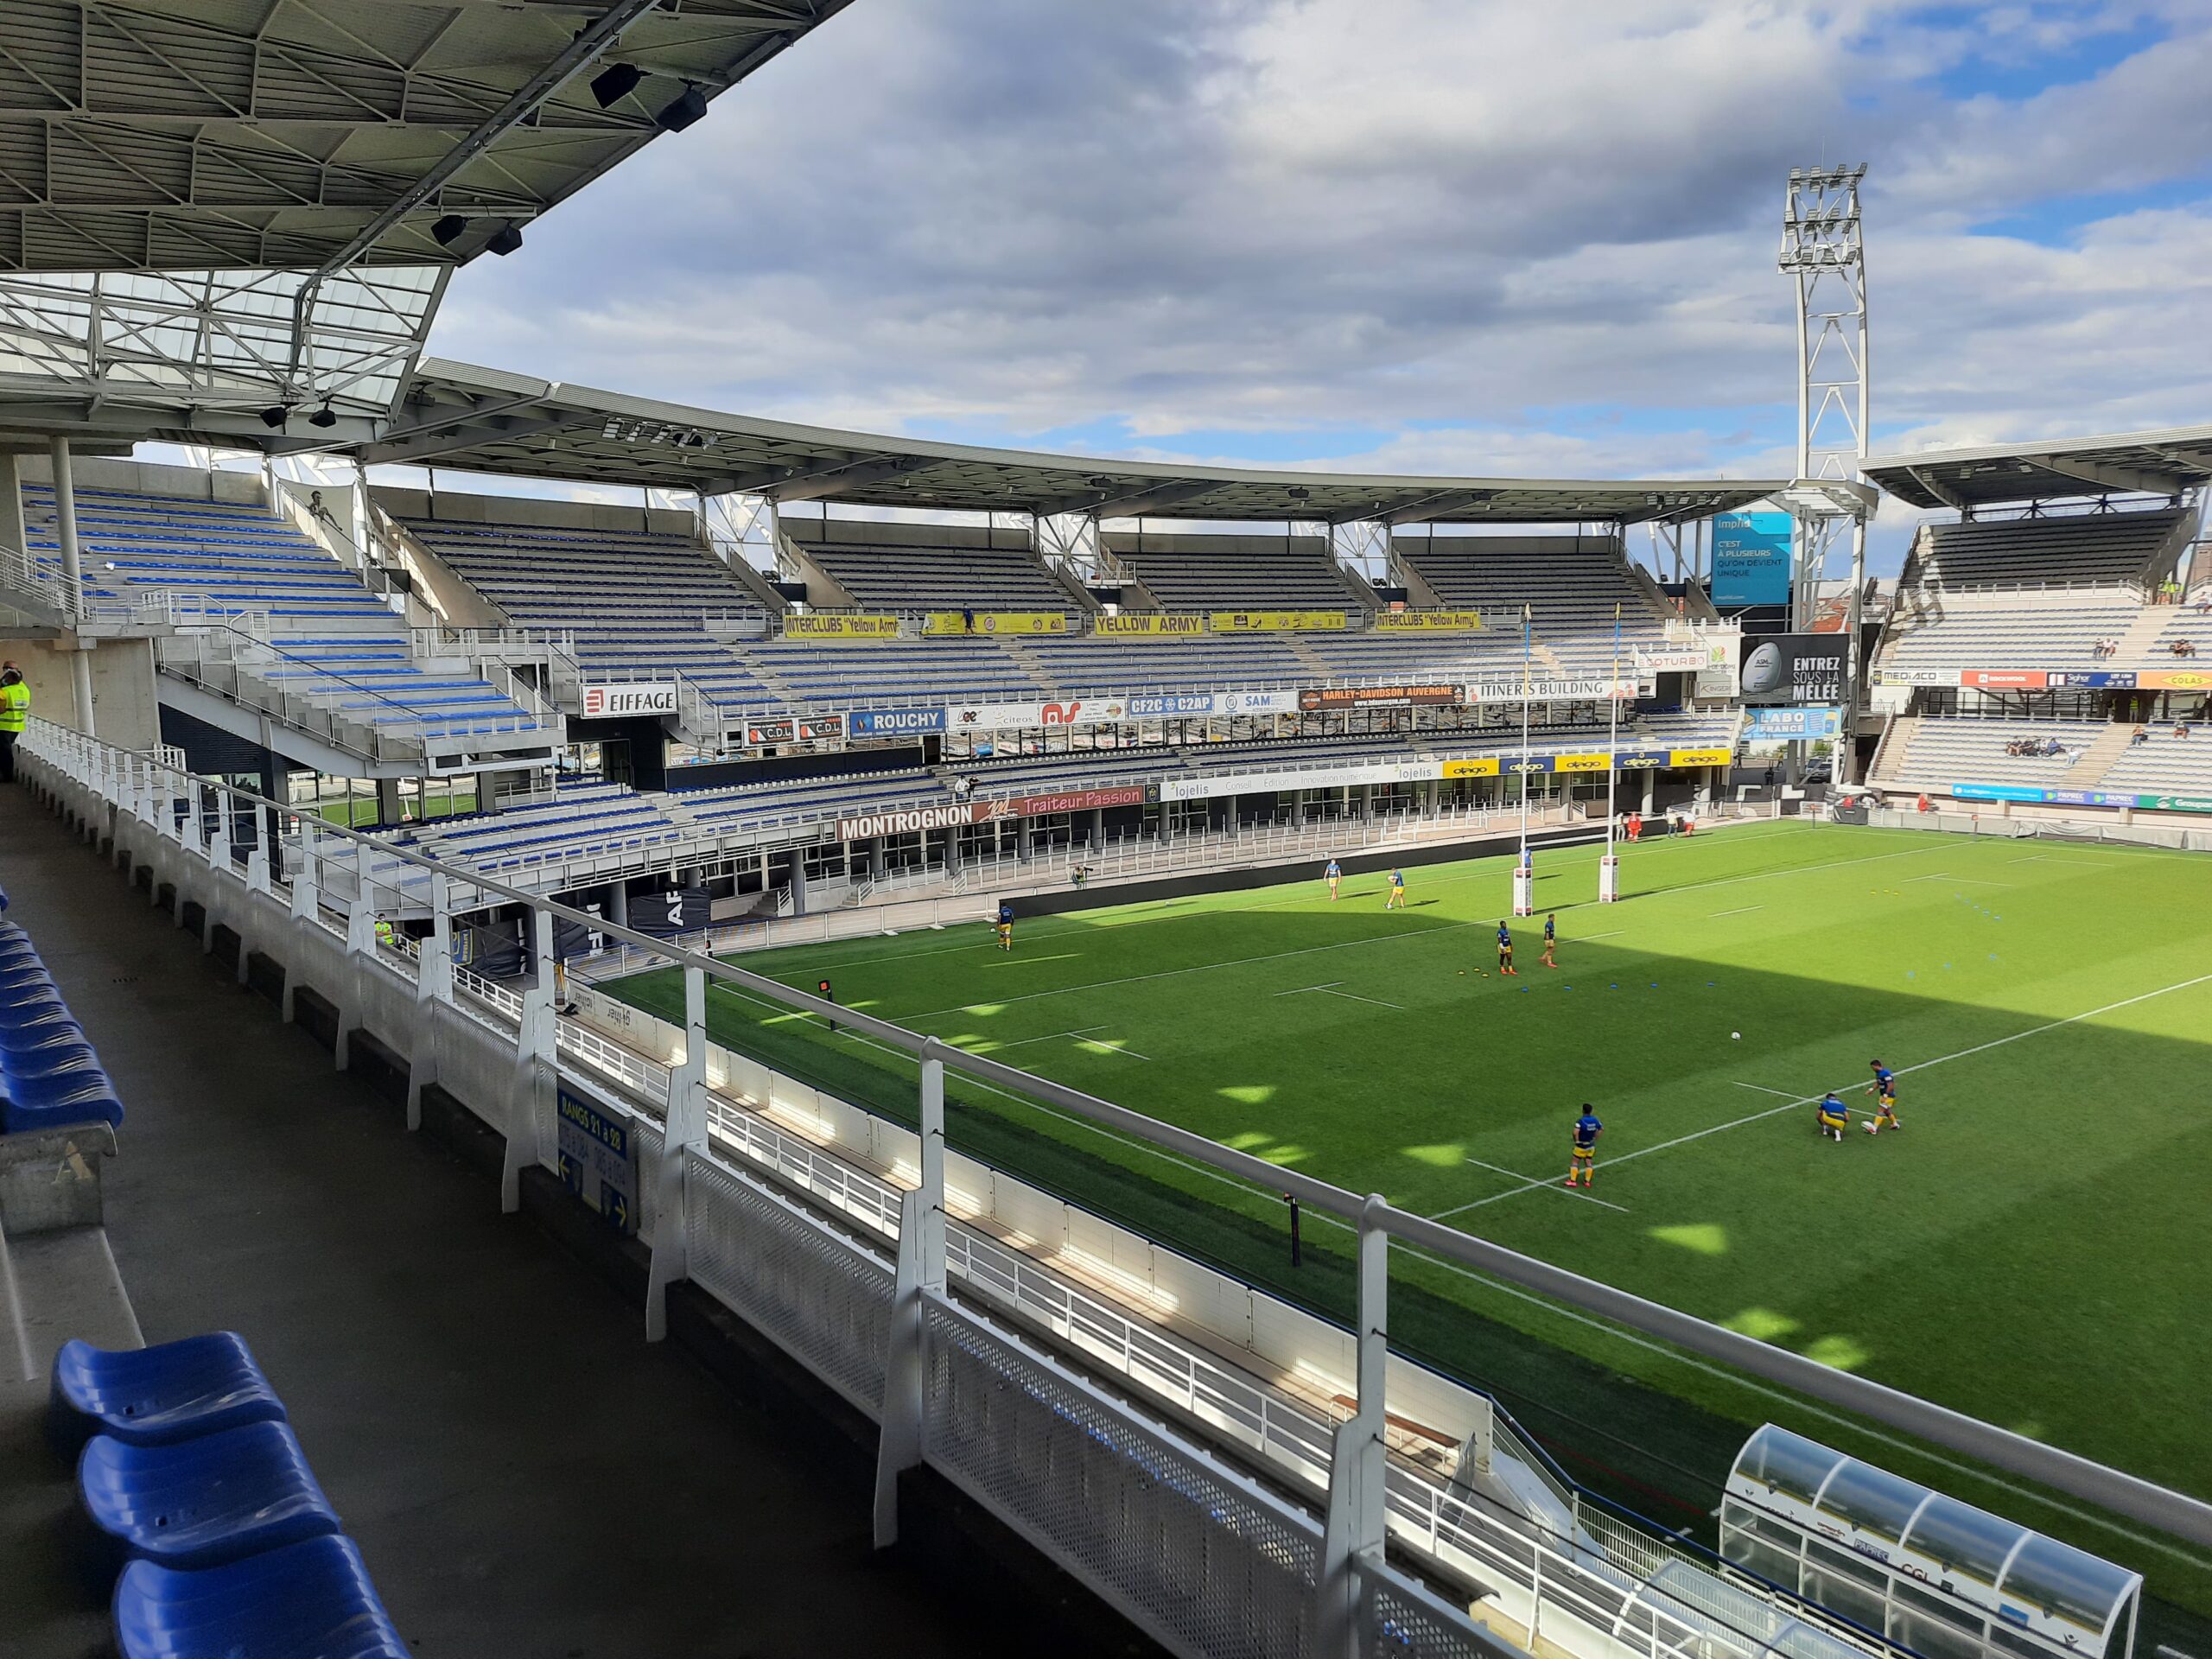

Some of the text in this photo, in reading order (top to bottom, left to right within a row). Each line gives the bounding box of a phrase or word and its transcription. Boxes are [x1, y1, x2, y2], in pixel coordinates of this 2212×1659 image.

[1746, 558, 1783, 567] DEVIENT
[1717, 569, 1750, 578] UNIQUE
[785, 617, 842, 633] INTERCLUBS
[1096, 616, 1199, 632] YELLOW ARMY
[1377, 613, 1424, 627] INTERCLUBS
[1793, 657, 1840, 671] ENTREZ
[1793, 671, 1840, 683] SOUS LA
[1322, 686, 1453, 701] HARLEY-DAVIDSON AUVERGNE
[1539, 682, 1604, 696] BUILDING
[1792, 681, 1840, 701] MÊLÉE
[610, 692, 674, 712] EIFFAGE
[1131, 696, 1210, 713] CF2C C2AP
[1245, 695, 1270, 707] SAM
[874, 711, 939, 729] ROUCHY
[1759, 712, 1805, 723] LABO
[1759, 724, 1805, 734] FRANCE
[1399, 766, 1432, 780] lojelis
[1225, 780, 1252, 791] Conseil
[1300, 775, 1338, 785] Innovation
[1339, 772, 1377, 783] numérique
[1175, 784, 1209, 799] lojelis
[842, 804, 973, 840] MONTROGNON
[1023, 796, 1083, 814] Traiteur
[1085, 790, 1141, 807] Passion
[562, 1096, 589, 1129] RANGS
[590, 1115, 601, 1137] 21
